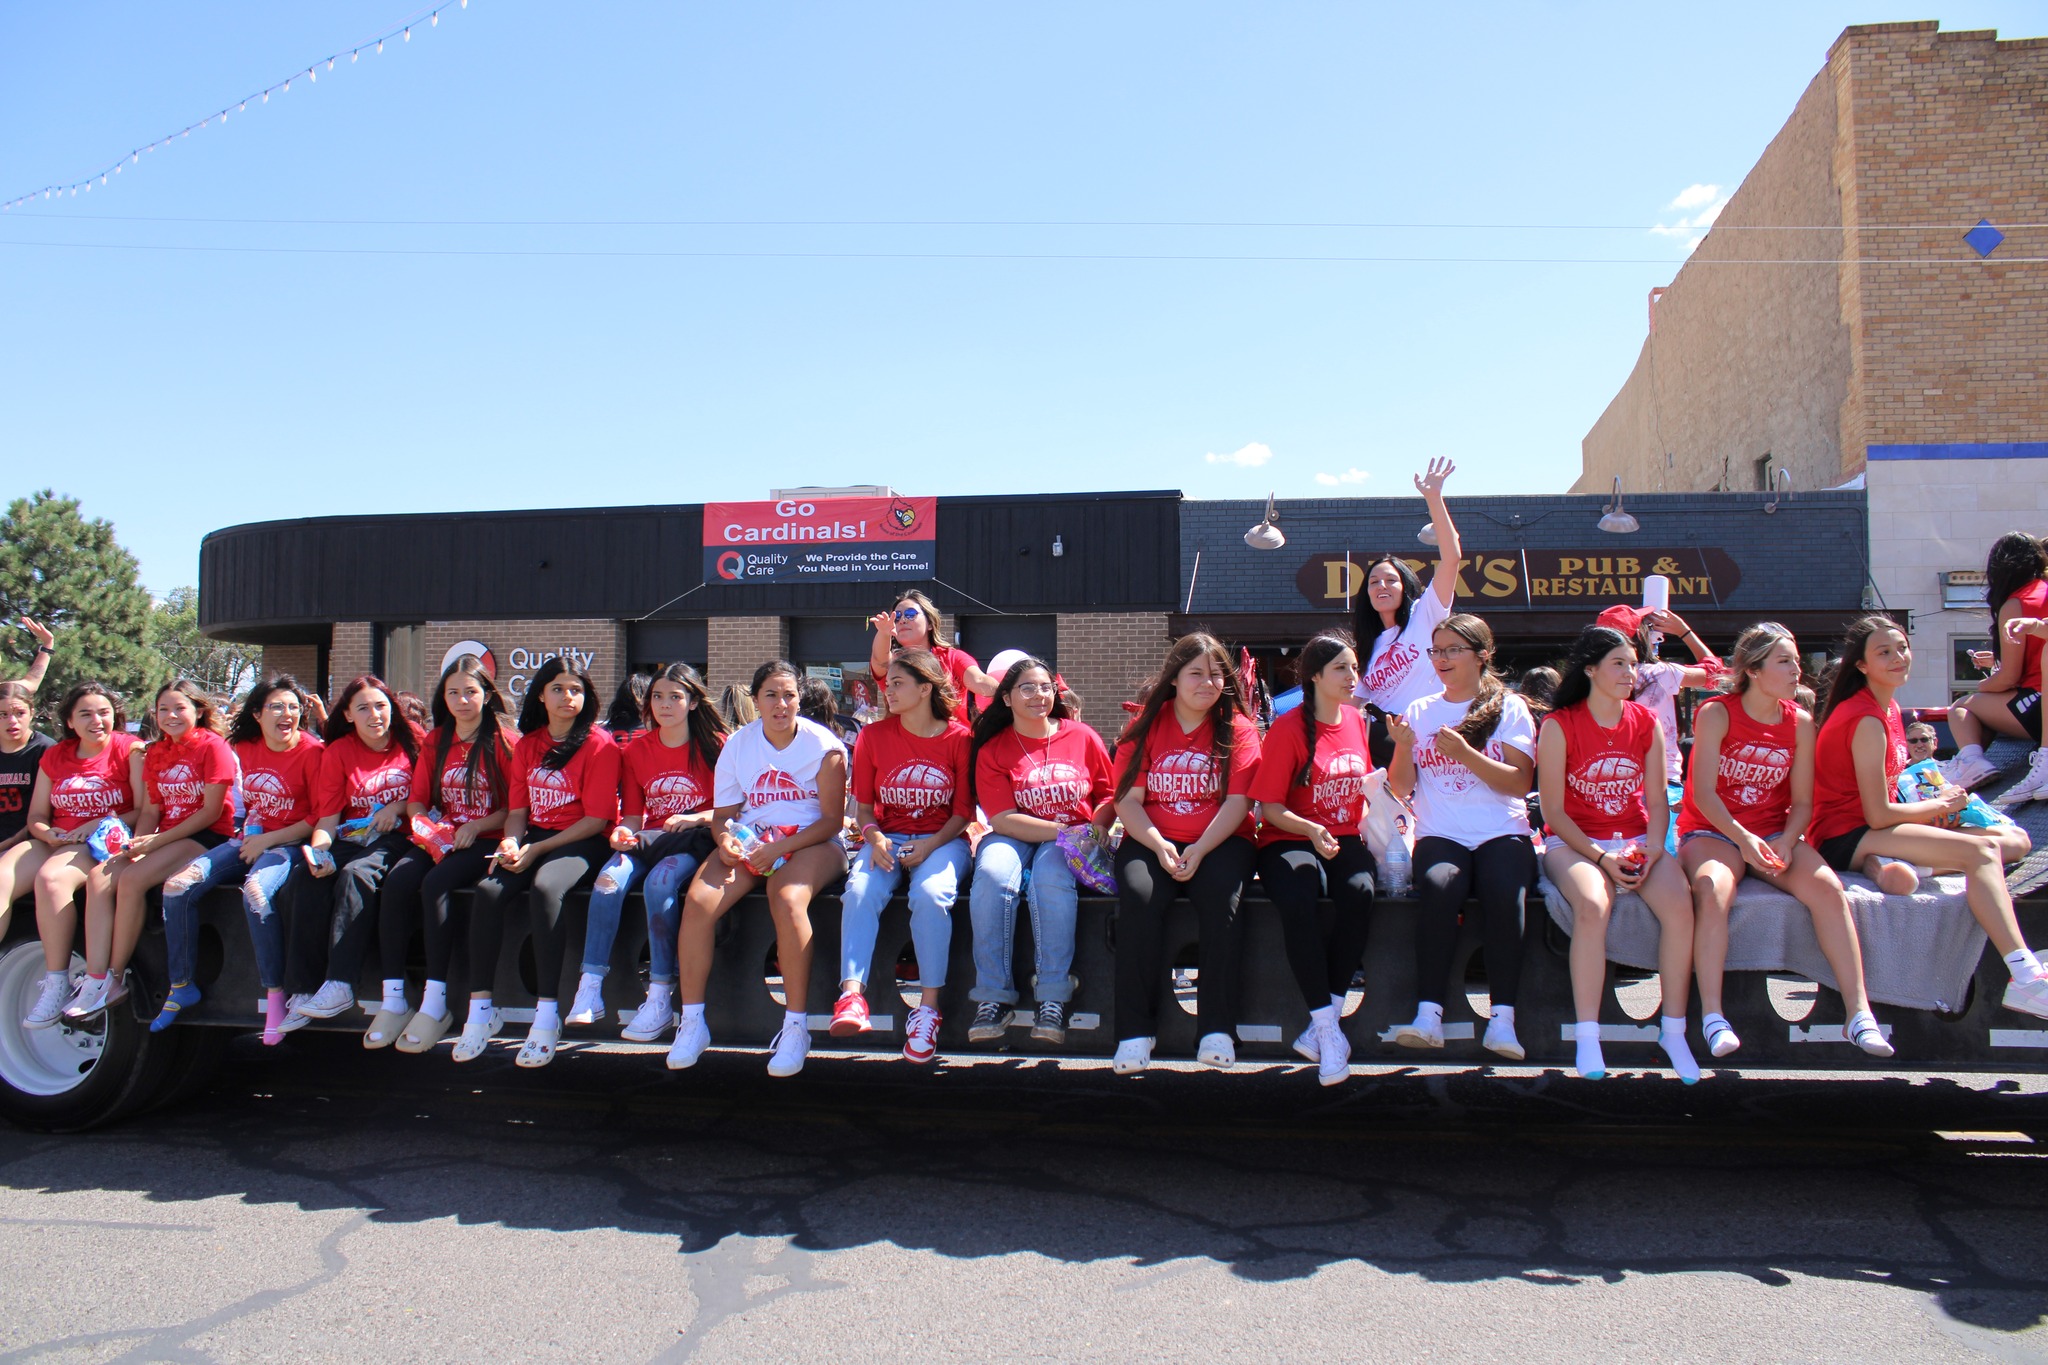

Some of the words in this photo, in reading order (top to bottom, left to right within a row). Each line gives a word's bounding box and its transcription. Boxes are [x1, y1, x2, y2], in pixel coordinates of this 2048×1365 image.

[775, 500, 815, 517] Go
[723, 521, 866, 542] Cardinals!
[747, 553, 789, 565] Quality
[806, 554, 823, 562] We
[825, 553, 868, 562] Provide
[870, 553, 888, 561] the
[890, 552, 917, 560] Care
[746, 565, 775, 576] Care
[797, 564, 818, 573] You
[820, 564, 849, 572] Need
[851, 563, 862, 571] in
[864, 563, 890, 571] Your
[893, 562, 929, 570] Home!
[1558, 557, 1641, 576] PUB
[1651, 556, 1682, 575] &
[1531, 576, 1712, 596] RESTAUANT
